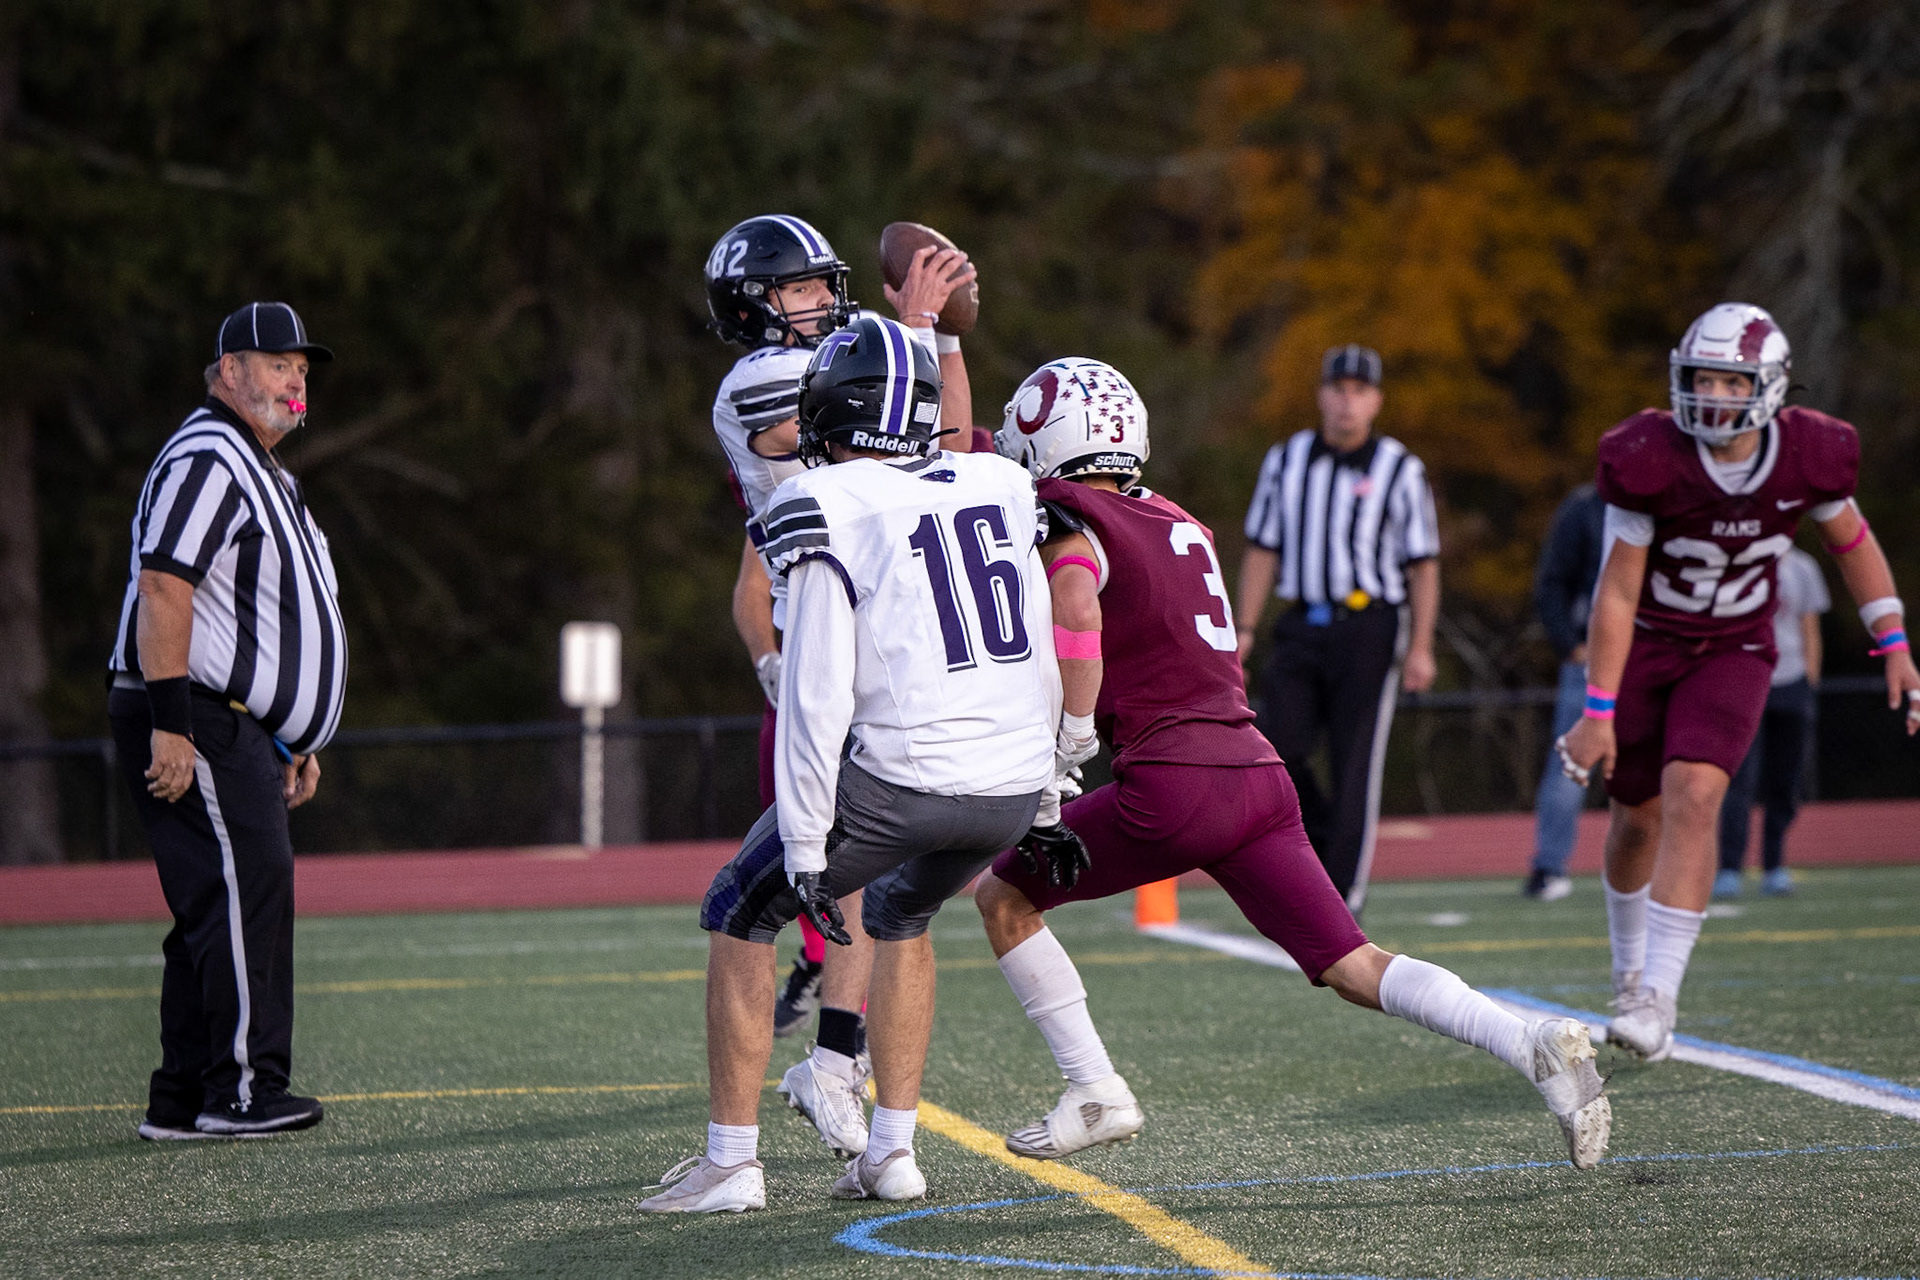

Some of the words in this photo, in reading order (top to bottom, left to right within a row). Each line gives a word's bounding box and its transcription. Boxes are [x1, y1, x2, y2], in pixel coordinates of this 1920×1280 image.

[711, 240, 748, 279] 82
[852, 430, 920, 454] Riddell
[1110, 415, 1124, 443] 3
[1094, 452, 1136, 467] schutt
[1711, 519, 1761, 537] RAMS
[908, 505, 1031, 673] 16
[1169, 522, 1238, 652] 3
[1651, 533, 1793, 618] 32
